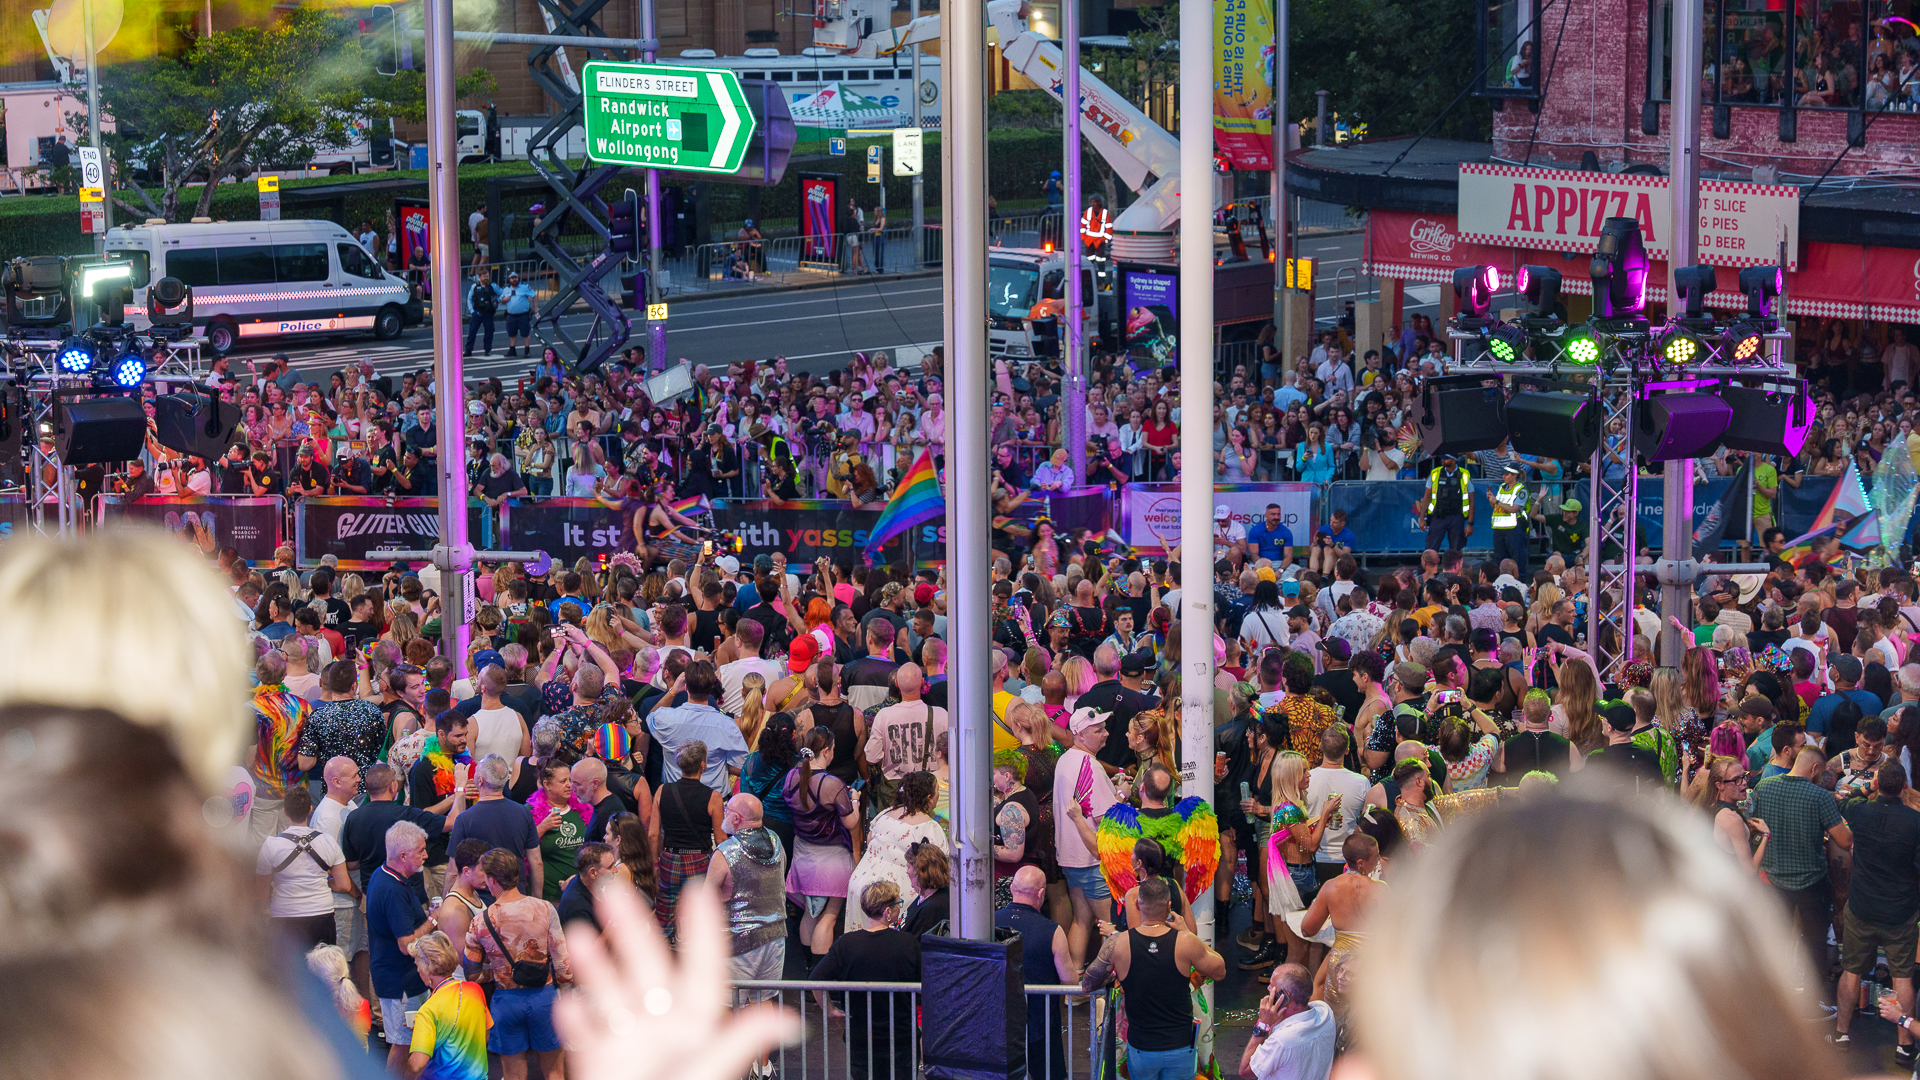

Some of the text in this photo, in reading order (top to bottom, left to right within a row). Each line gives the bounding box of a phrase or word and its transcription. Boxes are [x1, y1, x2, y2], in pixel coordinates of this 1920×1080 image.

[599, 76, 694, 93] FLINDERS STREET
[600, 97, 669, 117] Randwick
[610, 118, 662, 138] Airport
[1084, 104, 1134, 148] STAR
[596, 137, 678, 164] Wollongong
[837, 139, 844, 150] D
[82, 150, 97, 160] END
[87, 167, 98, 179] 40
[529, 159, 549, 180] SKYJACK
[1506, 183, 1656, 242] APPIZZA
[1713, 199, 1746, 213] SLICE
[1712, 217, 1739, 231] PIES
[1410, 218, 1455, 248] Grifter
[1716, 236, 1745, 250] BEER
[1410, 252, 1439, 260] BREWING
[1130, 276, 1147, 284] Sydney
[279, 321, 322, 332] Police
[337, 512, 439, 540] GLITTER CLU
[563, 522, 585, 547] It
